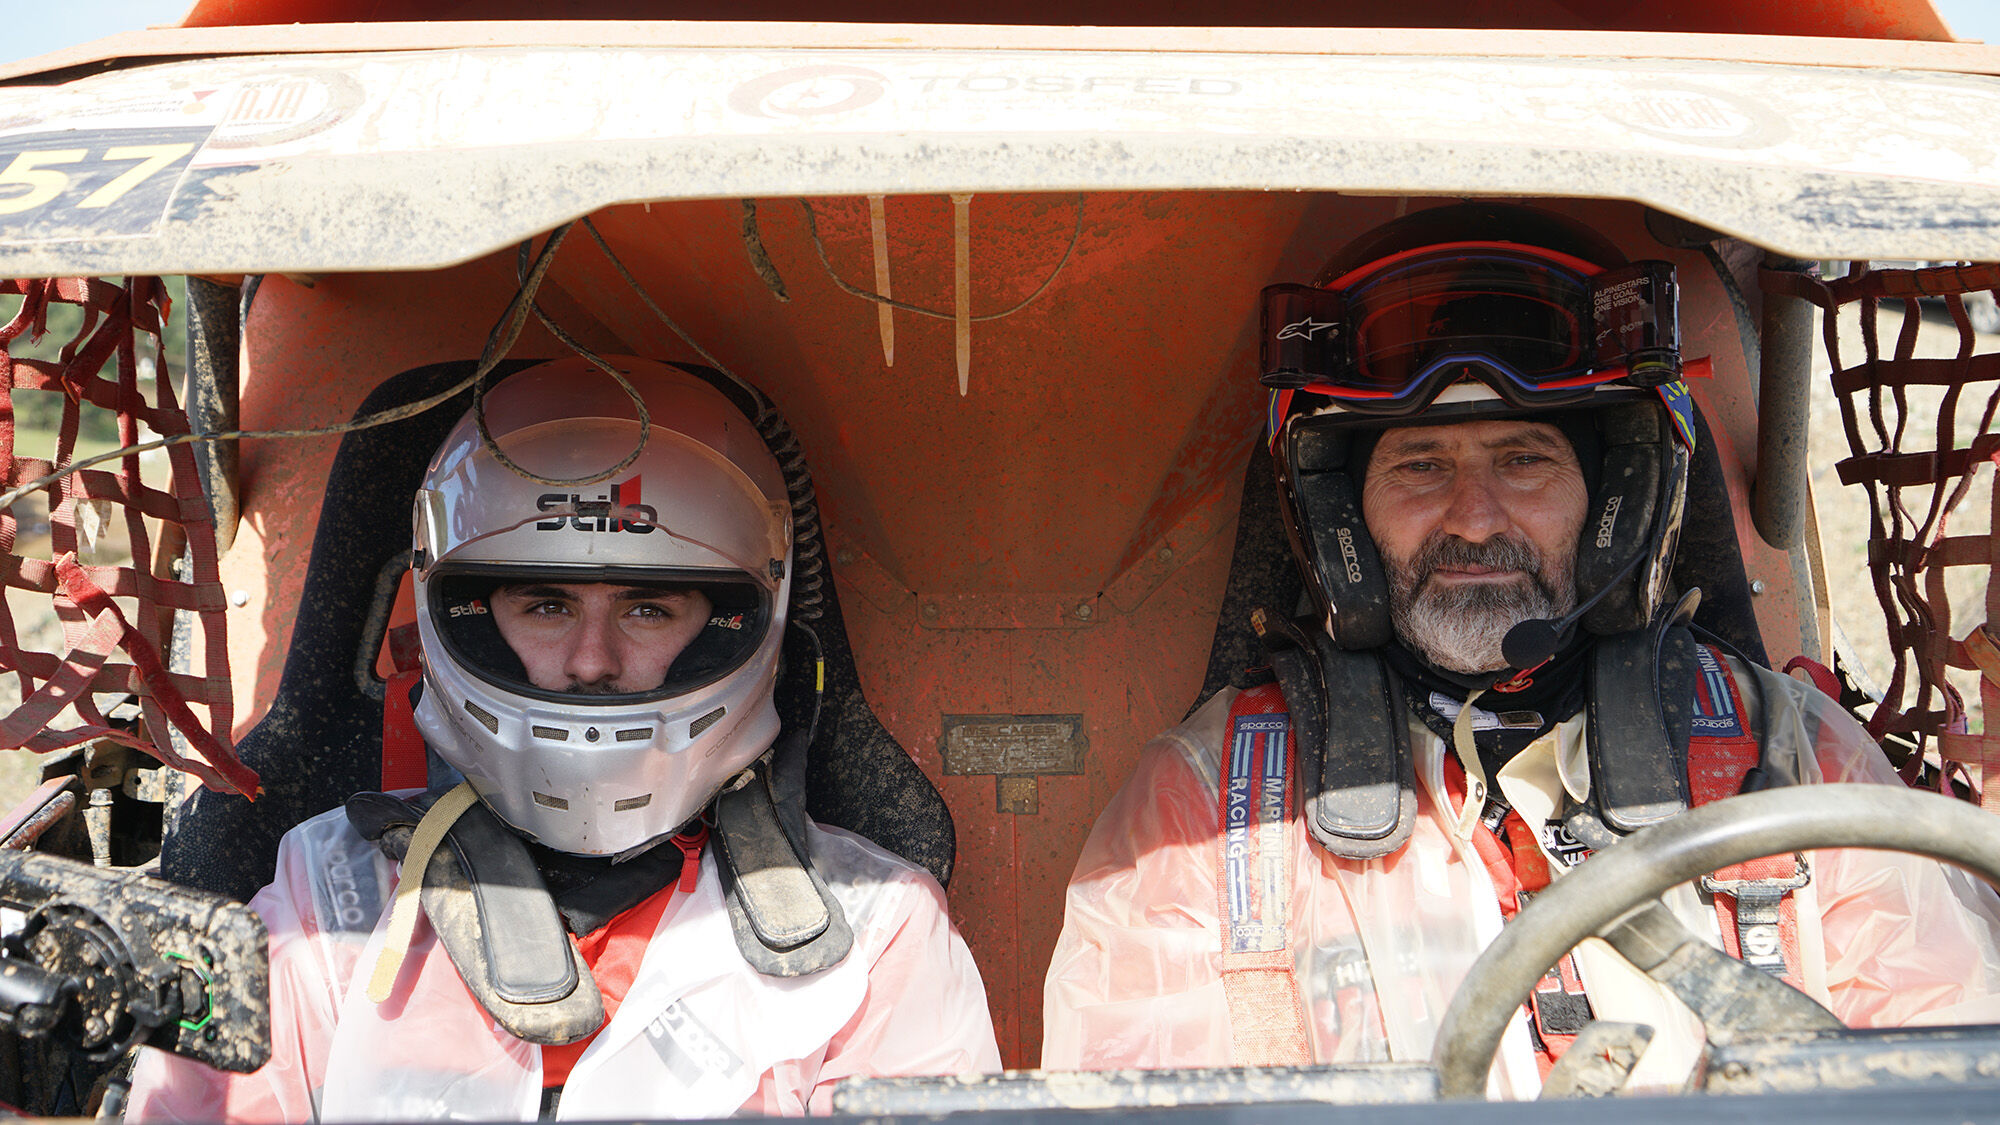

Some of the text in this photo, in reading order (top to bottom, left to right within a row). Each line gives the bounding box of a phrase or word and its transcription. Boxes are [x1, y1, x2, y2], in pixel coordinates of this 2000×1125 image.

[908, 73, 1243, 97] TOSFED
[0, 143, 195, 216] 57
[1593, 276, 1650, 299] ALPINESTARS
[1594, 293, 1612, 307] ONE
[1594, 301, 1612, 314] ONE
[536, 474, 658, 534] Stilo
[1596, 495, 1623, 549] sparco
[1336, 526, 1363, 584] sparco
[1239, 720, 1284, 731] sparco
[1228, 776, 1248, 859] RACING
